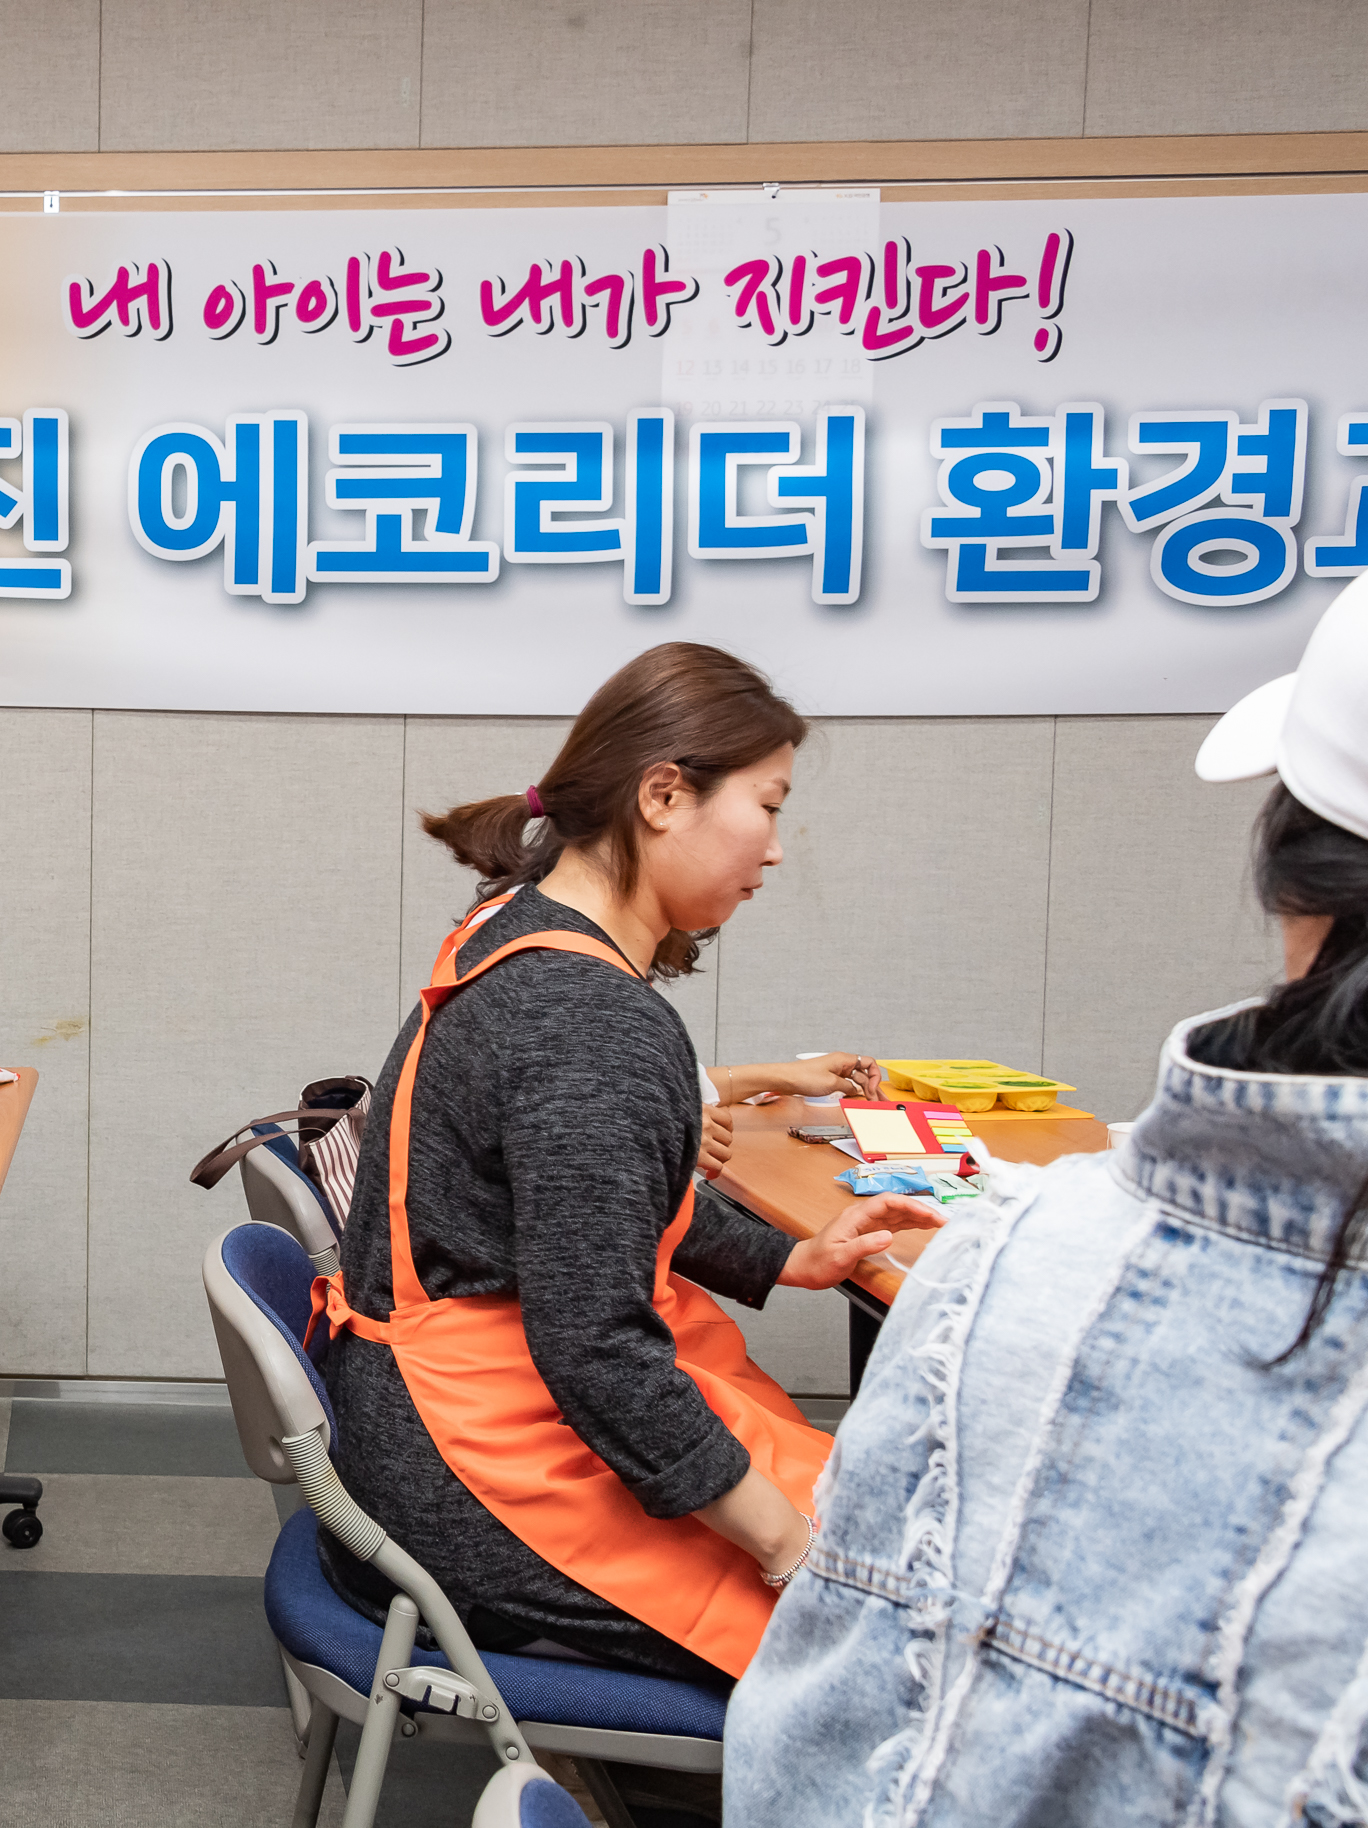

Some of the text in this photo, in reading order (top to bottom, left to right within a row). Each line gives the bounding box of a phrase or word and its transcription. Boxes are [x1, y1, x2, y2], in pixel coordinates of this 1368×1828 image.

[66, 259, 168, 335] 내
[200, 248, 444, 361] 아이는
[477, 245, 694, 344] 내가
[721, 229, 1068, 357] 지킨다!
[133, 410, 861, 599] 에코리더
